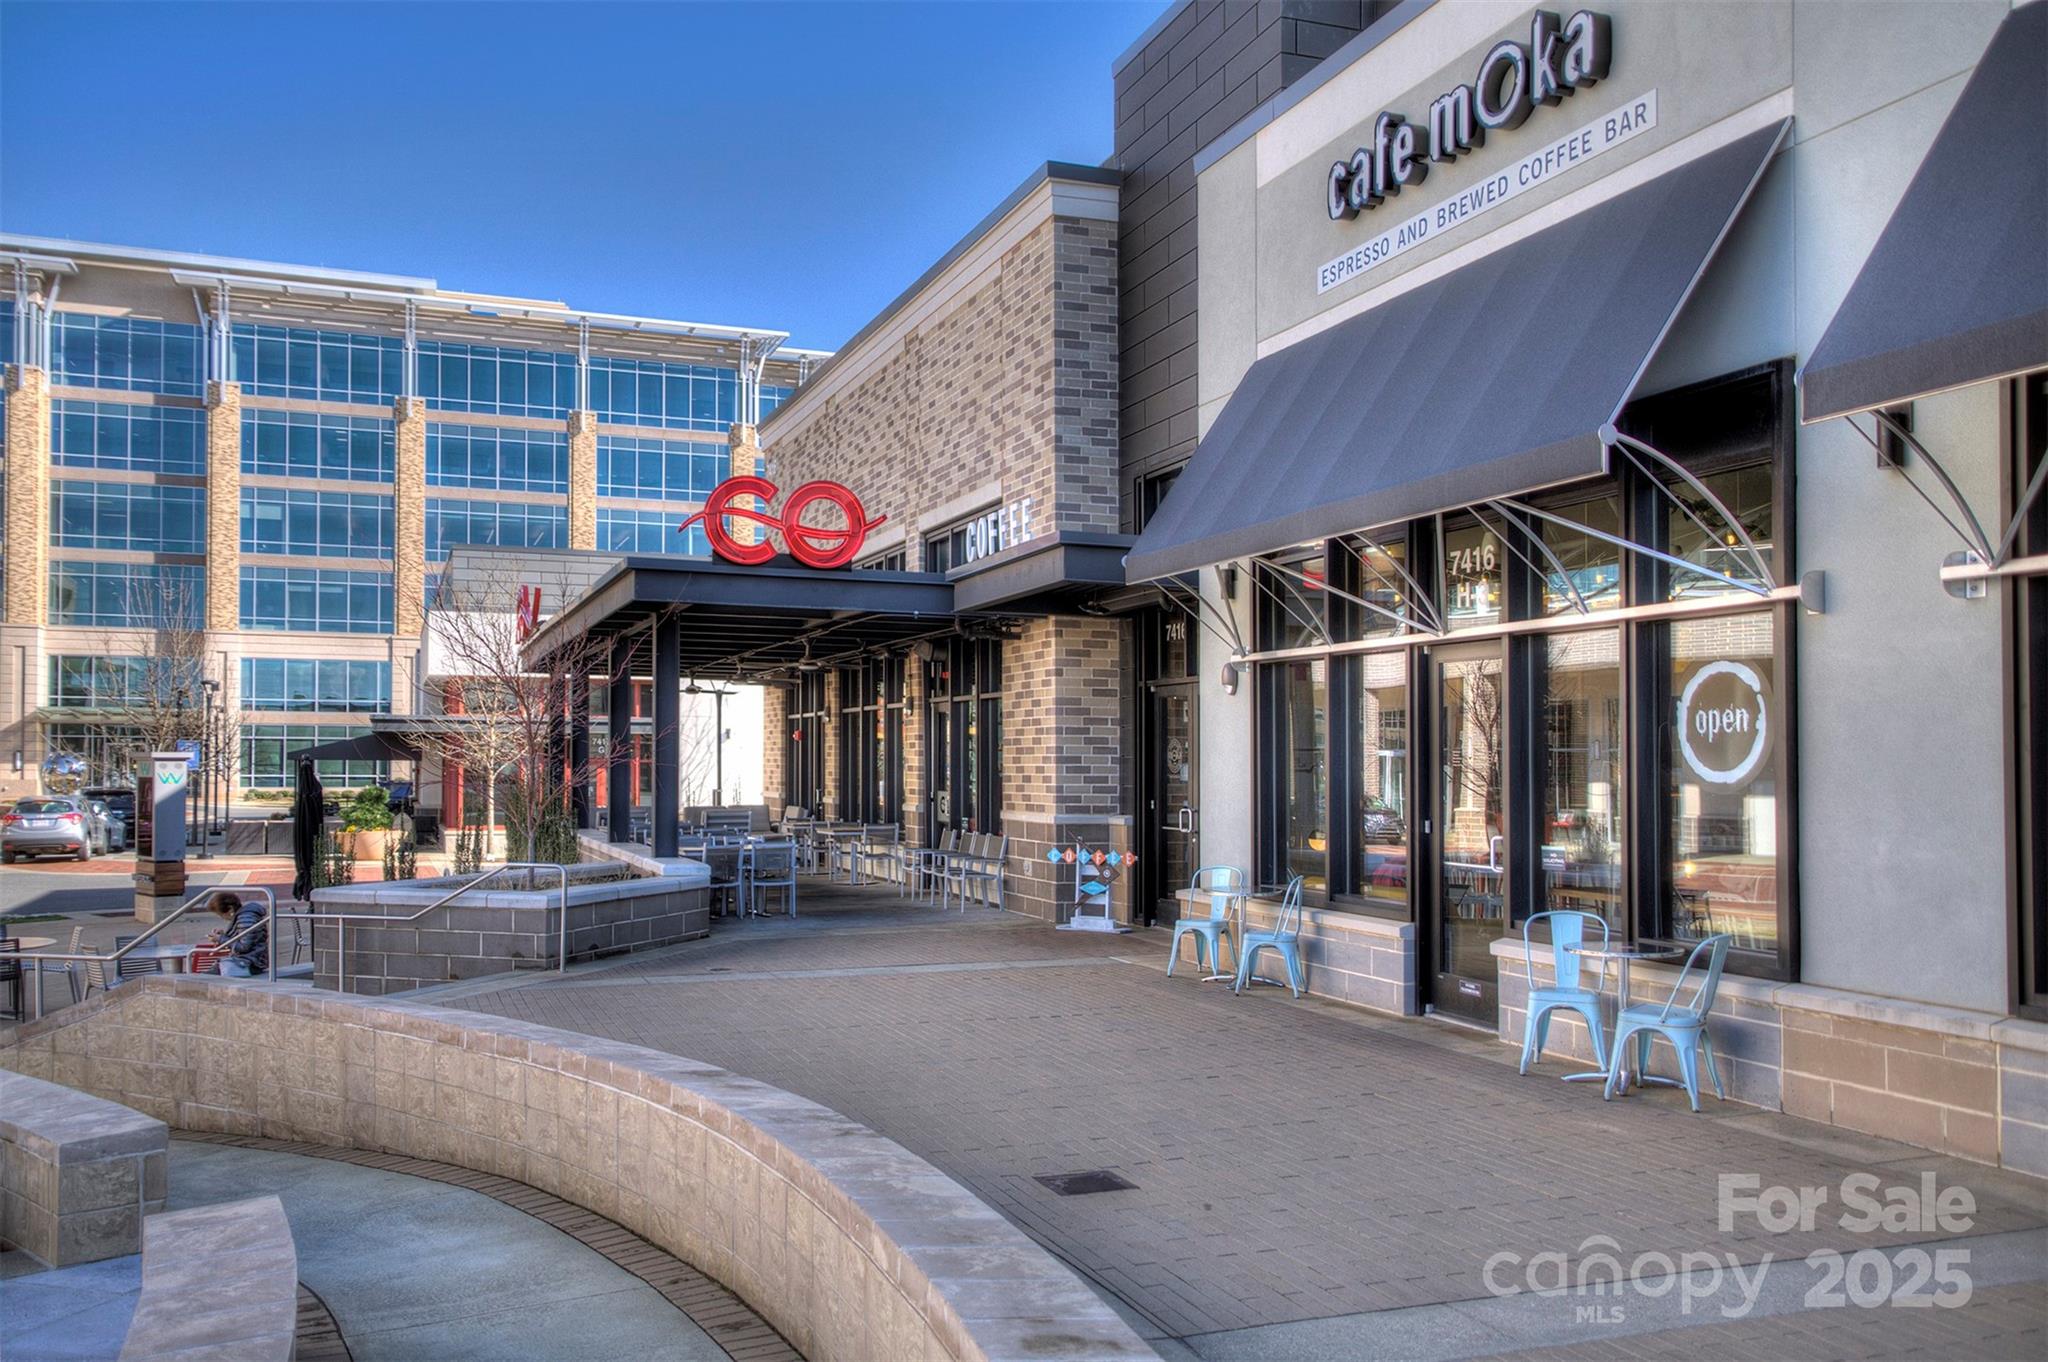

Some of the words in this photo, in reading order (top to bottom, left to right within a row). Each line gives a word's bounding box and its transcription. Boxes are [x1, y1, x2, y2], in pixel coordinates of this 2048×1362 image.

[1321, 237, 1390, 288] ESPRESSO
[1397, 217, 1429, 249] AND
[1436, 175, 1508, 229] BREWED
[1518, 129, 1593, 185] COFFEE
[1605, 101, 1647, 143] BAR
[1327, 111, 1427, 220] cafe
[966, 498, 1034, 563] COFFEE
[1450, 544, 1495, 576] 7416
[1696, 707, 1749, 743] open
